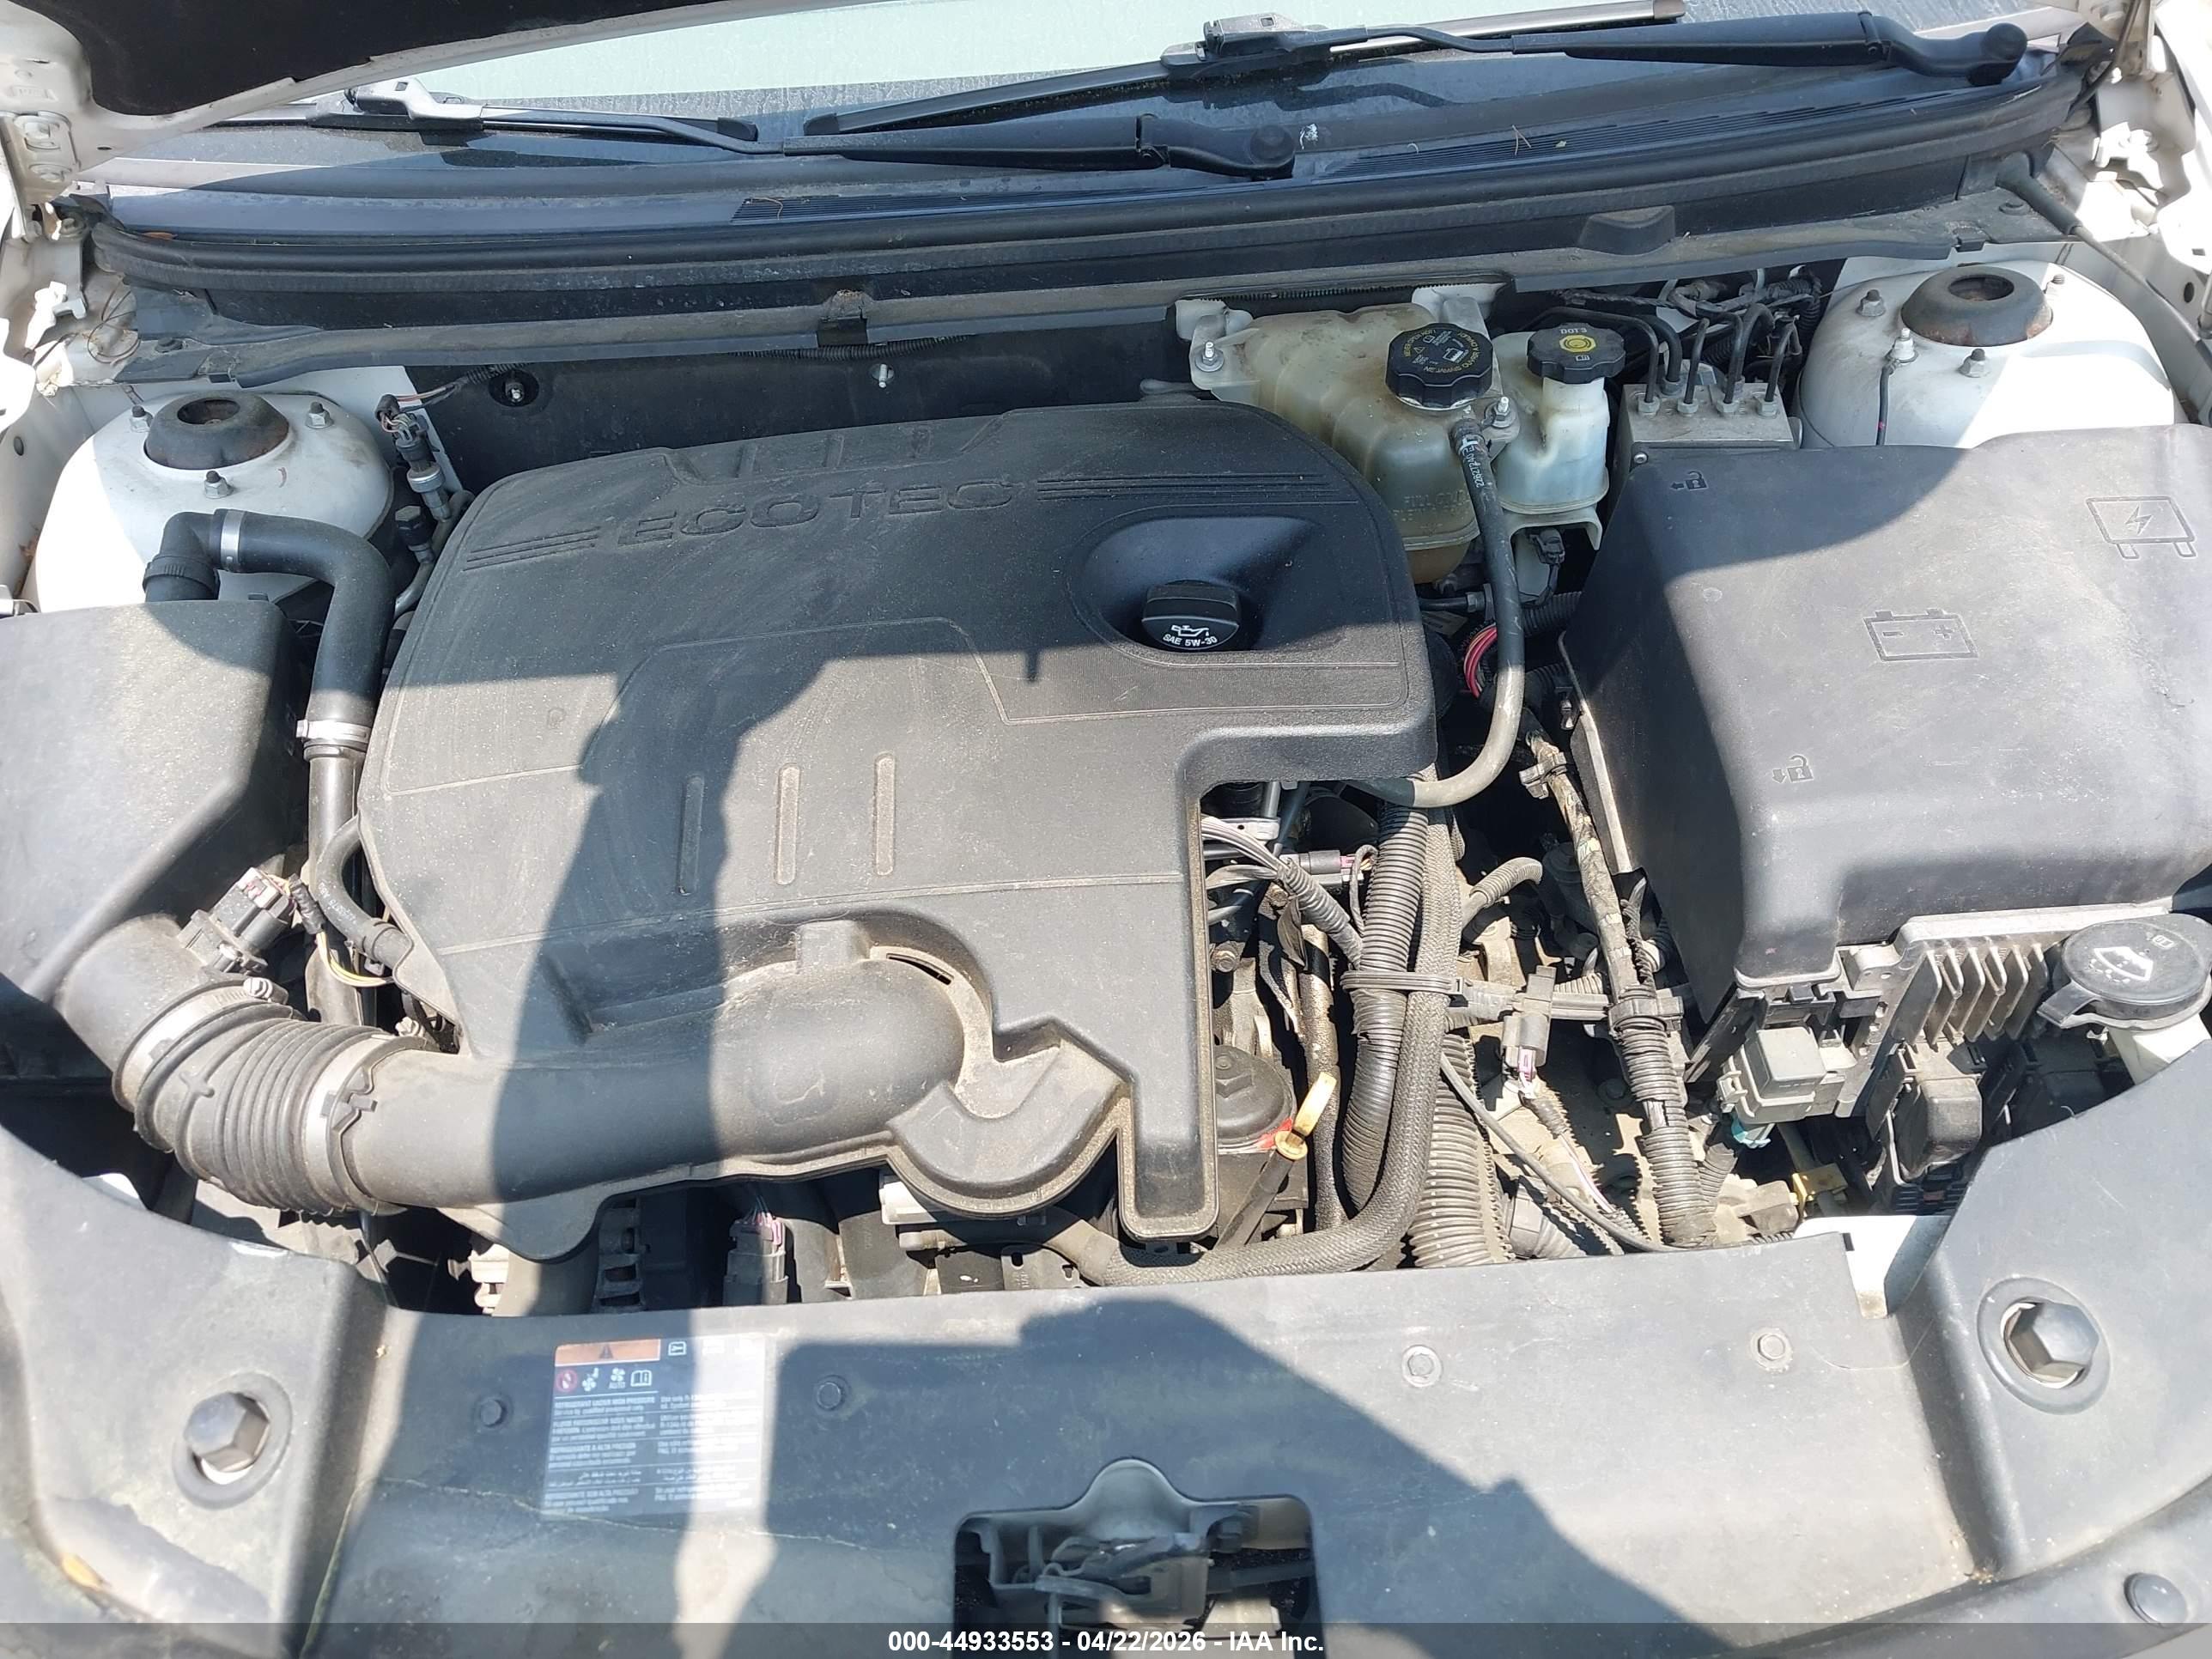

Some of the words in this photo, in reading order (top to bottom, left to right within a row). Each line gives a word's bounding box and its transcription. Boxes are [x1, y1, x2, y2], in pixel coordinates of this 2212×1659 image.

[617, 481, 1015, 547] ECOTEC
[1163, 634, 1182, 645] SAE
[1185, 635, 1218, 647] 5W-30
